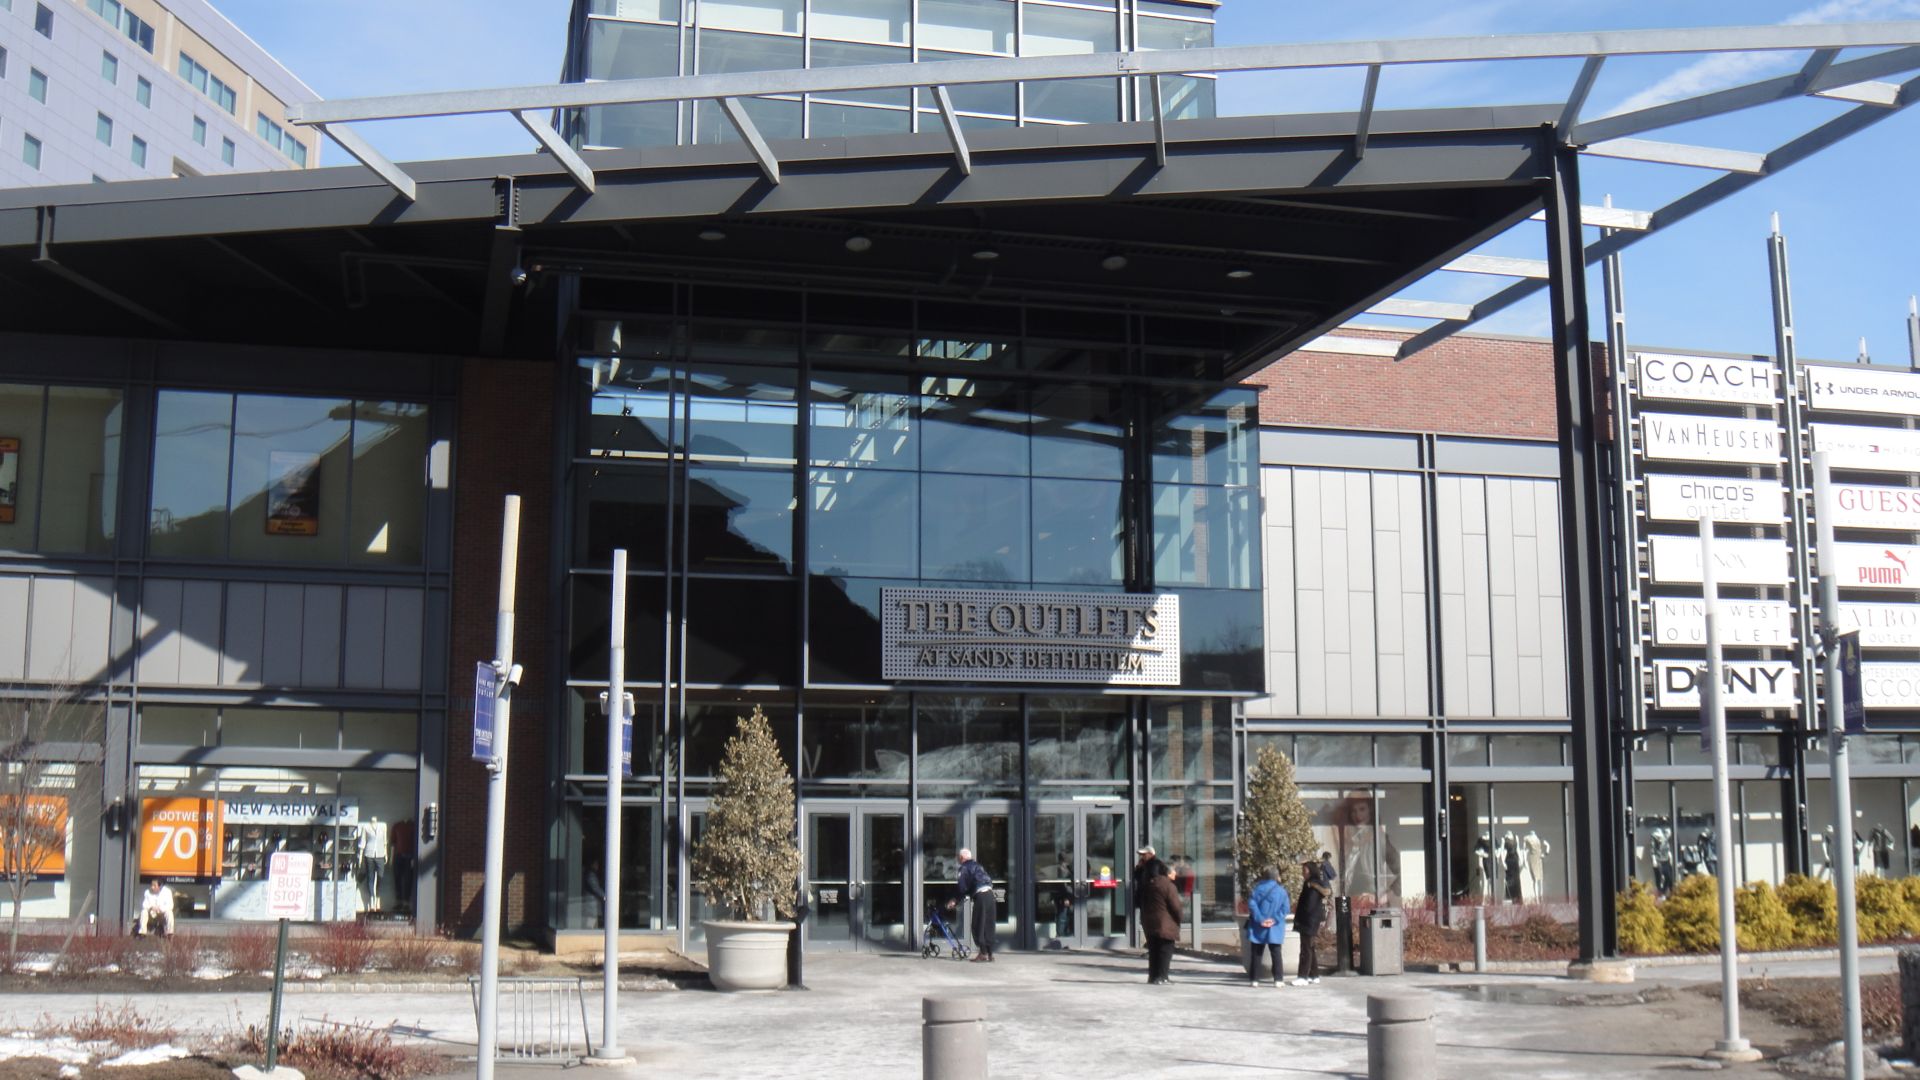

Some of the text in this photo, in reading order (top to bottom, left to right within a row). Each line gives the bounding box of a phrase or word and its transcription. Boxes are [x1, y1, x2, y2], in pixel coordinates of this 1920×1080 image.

[1645, 359, 1770, 389] COACH
[1839, 386, 1879, 396] UNDER
[1838, 488, 1920, 513] GUESS
[1858, 566, 1902, 585] PUMA
[900, 601, 1162, 638] THE OUTLETS
[1665, 603, 1780, 619] NIN WEST
[1839, 607, 1918, 628] ALBO
[1666, 627, 1780, 642] OULET
[917, 650, 1145, 671] AT SANDS BETHLEHEM
[1665, 665, 1786, 695] DNY
[228, 802, 349, 817] NEW ARRIVALS
[277, 876, 302, 889] BUS
[274, 890, 304, 902] STOP
